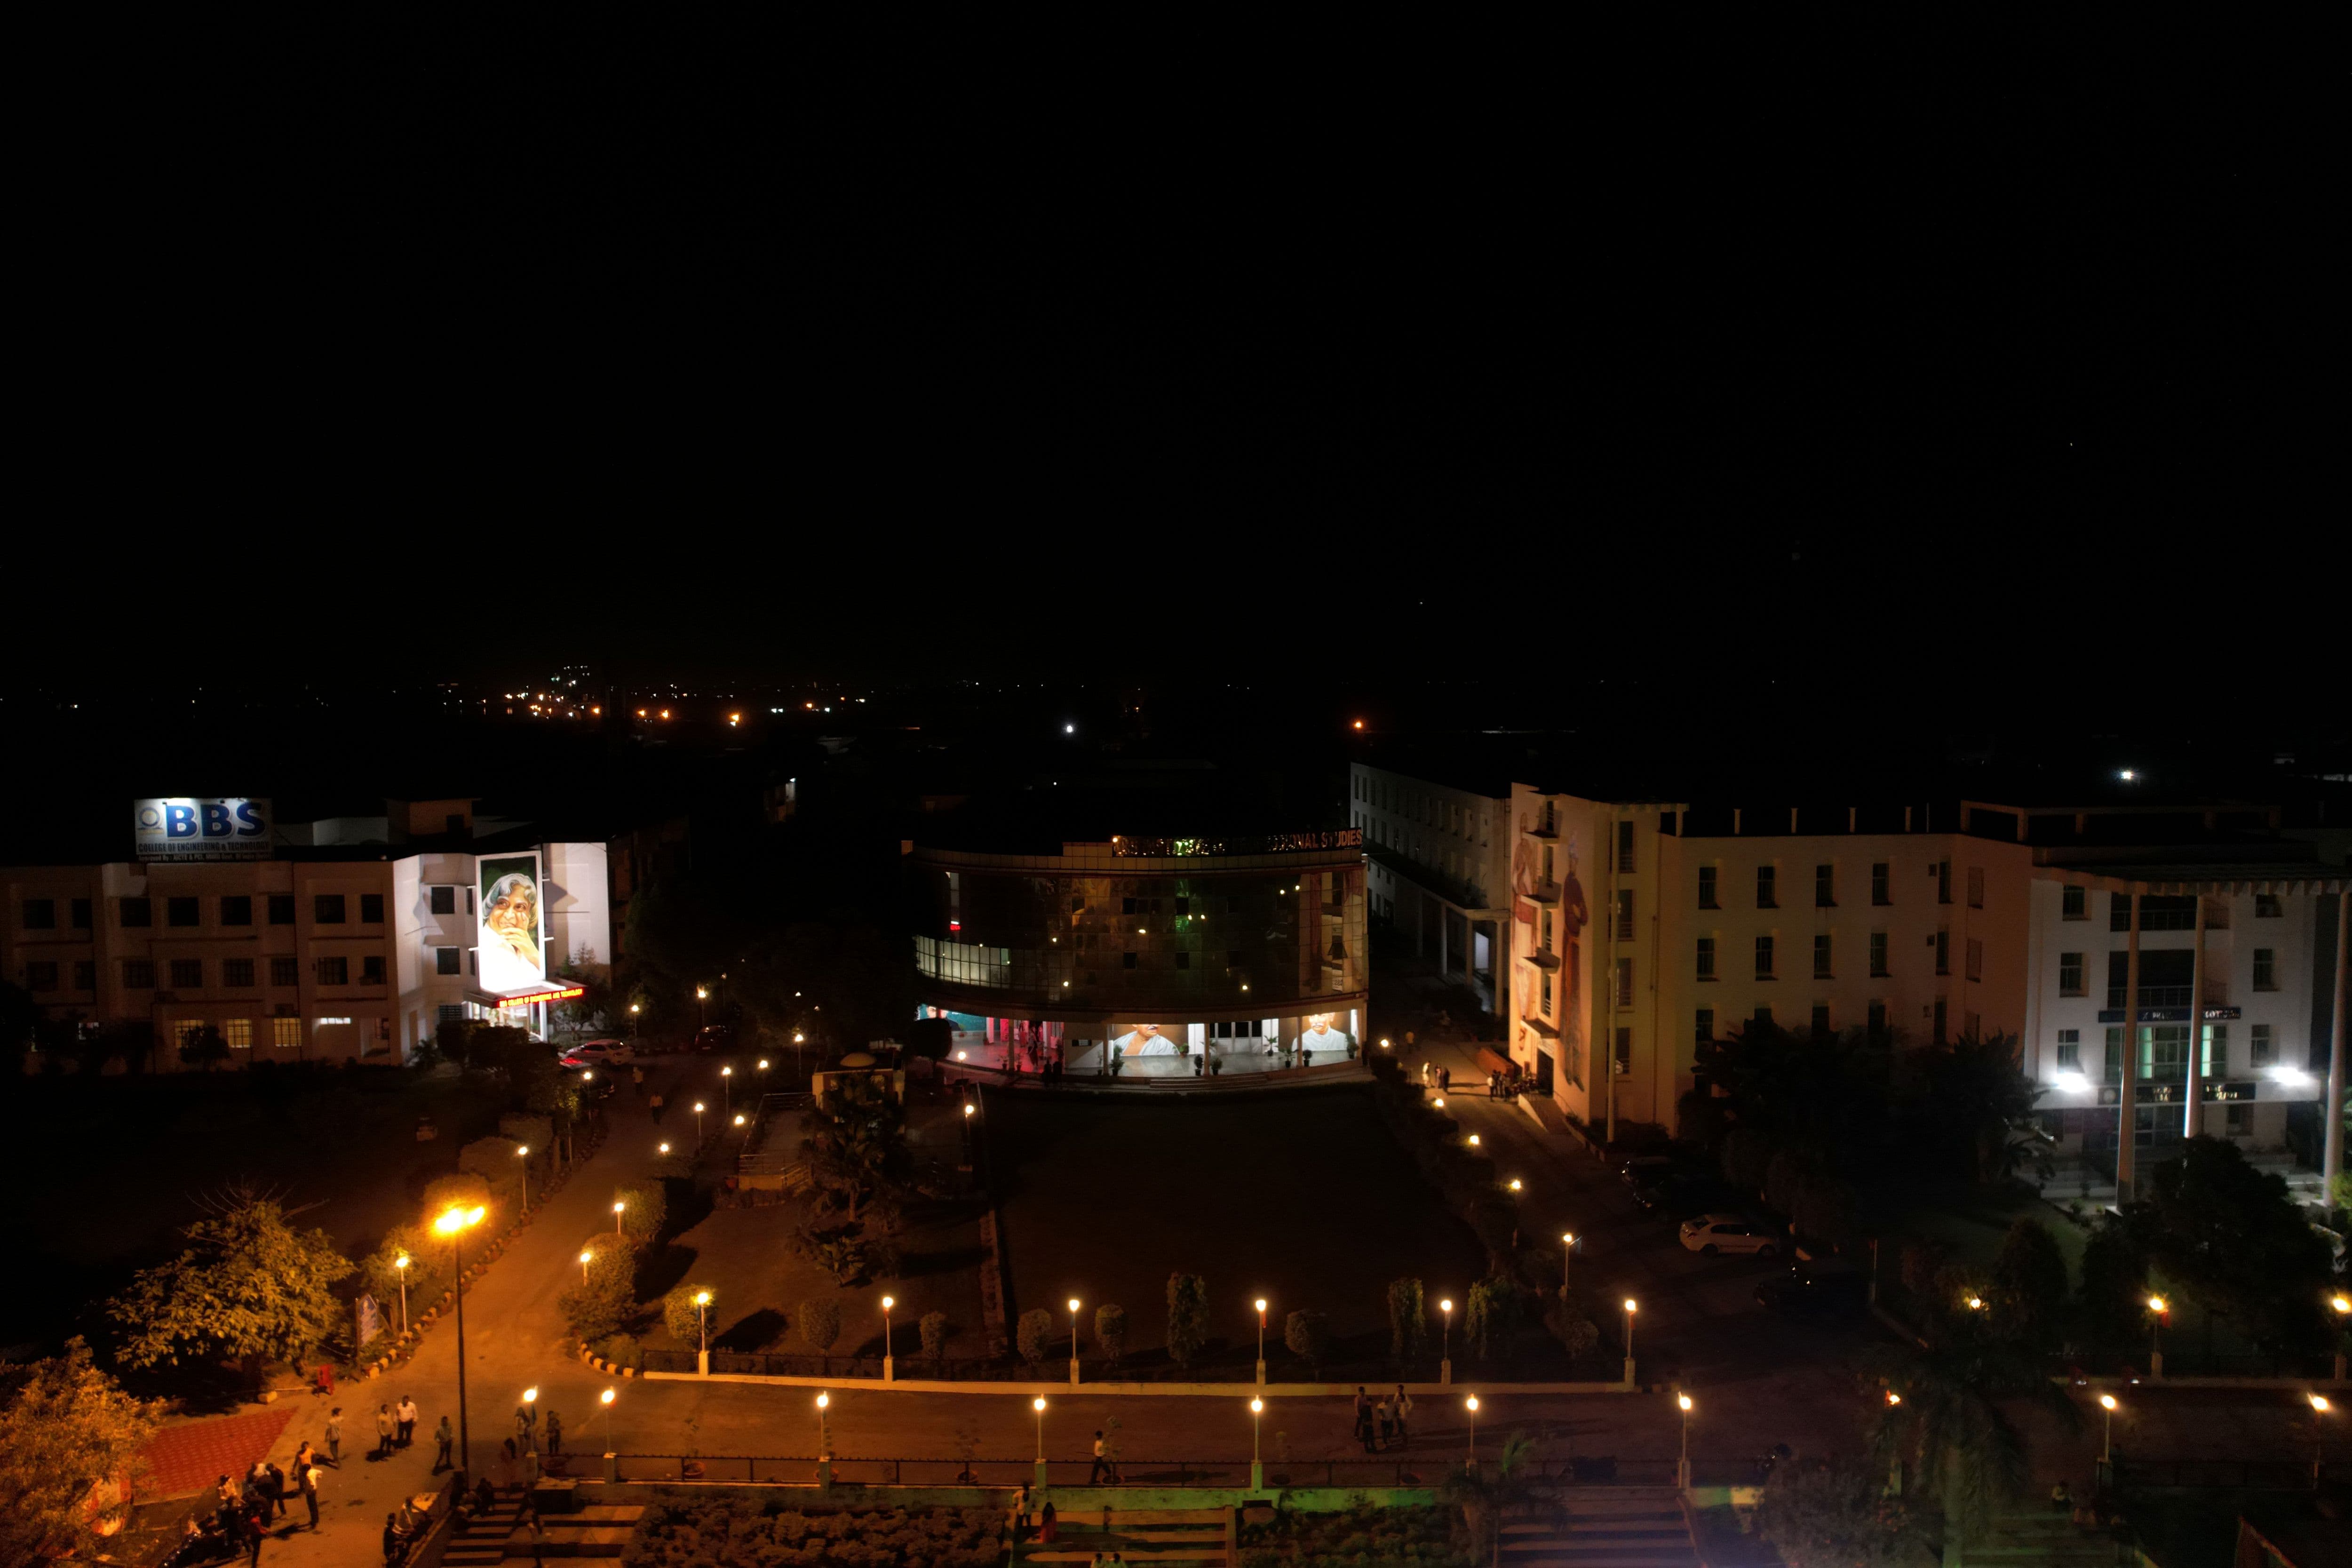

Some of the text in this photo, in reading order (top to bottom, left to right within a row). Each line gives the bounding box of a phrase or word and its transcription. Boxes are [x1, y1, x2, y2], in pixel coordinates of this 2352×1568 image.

[166, 802, 265, 837] BBS
[138, 843, 166, 852] COLLEGE
[167, 843, 175, 851] OF
[177, 842, 220, 852] ENGINEERING
[228, 841, 269, 851] TECHNOLOGY
